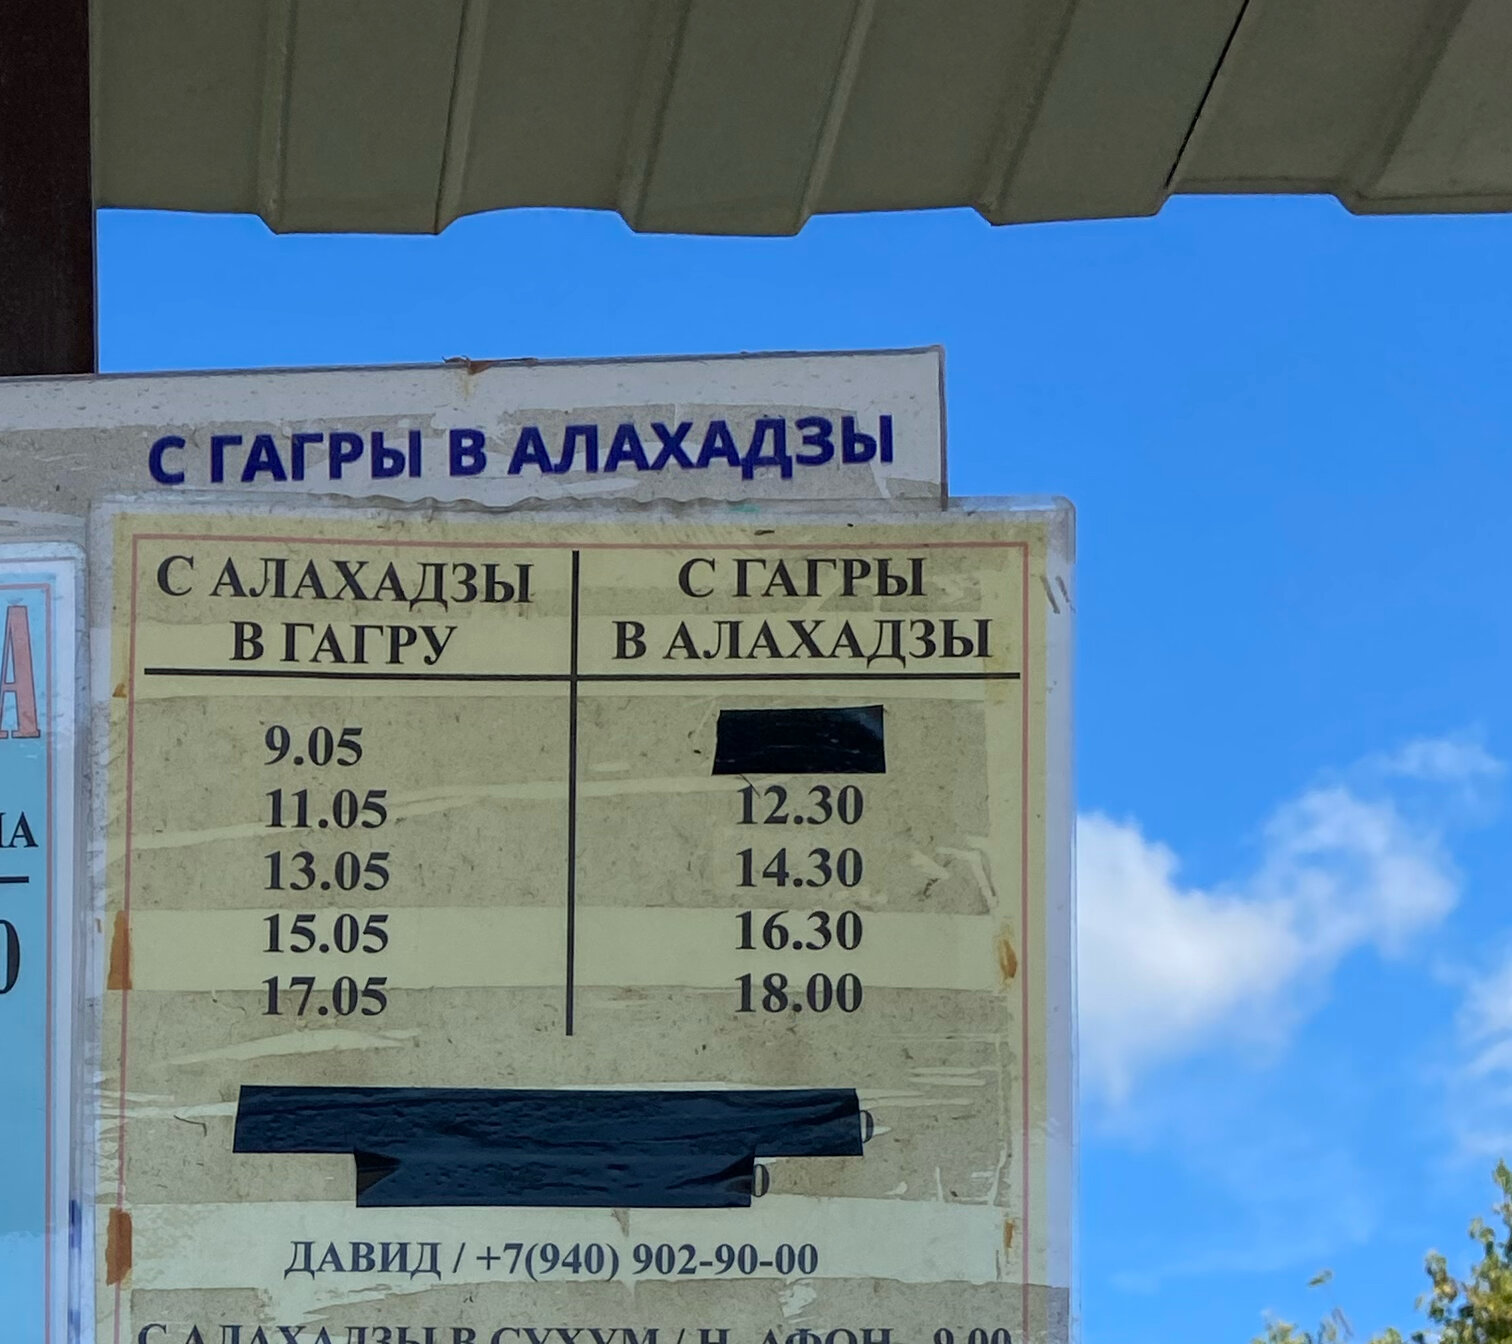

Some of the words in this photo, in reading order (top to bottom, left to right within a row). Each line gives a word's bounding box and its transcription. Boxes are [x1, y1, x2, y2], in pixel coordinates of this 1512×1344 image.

[149, 436, 185, 485] С
[211, 430, 421, 483] ГАГРЫ
[450, 429, 486, 476] В
[508, 415, 893, 480] АЛАХАДЗЫ
[157, 556, 193, 596] С
[210, 557, 533, 612] АЛАХАДЗЫ
[679, 558, 715, 597] С
[733, 558, 926, 597] ГАГРЫ
[230, 621, 263, 660] В
[280, 623, 457, 665] ГАГРУ
[613, 621, 646, 659] В
[663, 619, 992, 668] АЛАХАДЗЫ
[265, 726, 362, 766] 9.05
[267, 789, 387, 828] 11.05
[738, 783, 863, 825] 12.30
[265, 851, 389, 890] 13.05
[737, 848, 862, 887] 14.30
[264, 914, 388, 953] 15.05
[736, 911, 862, 950] 16.30
[263, 976, 387, 1016] 17.05
[736, 973, 862, 1013] 18.00
[284, 1242, 441, 1280] ДАВИД
[453, 1243, 465, 1273] /
[477, 1243, 619, 1283] +7(940)
[633, 1244, 818, 1274] 902-90-00
